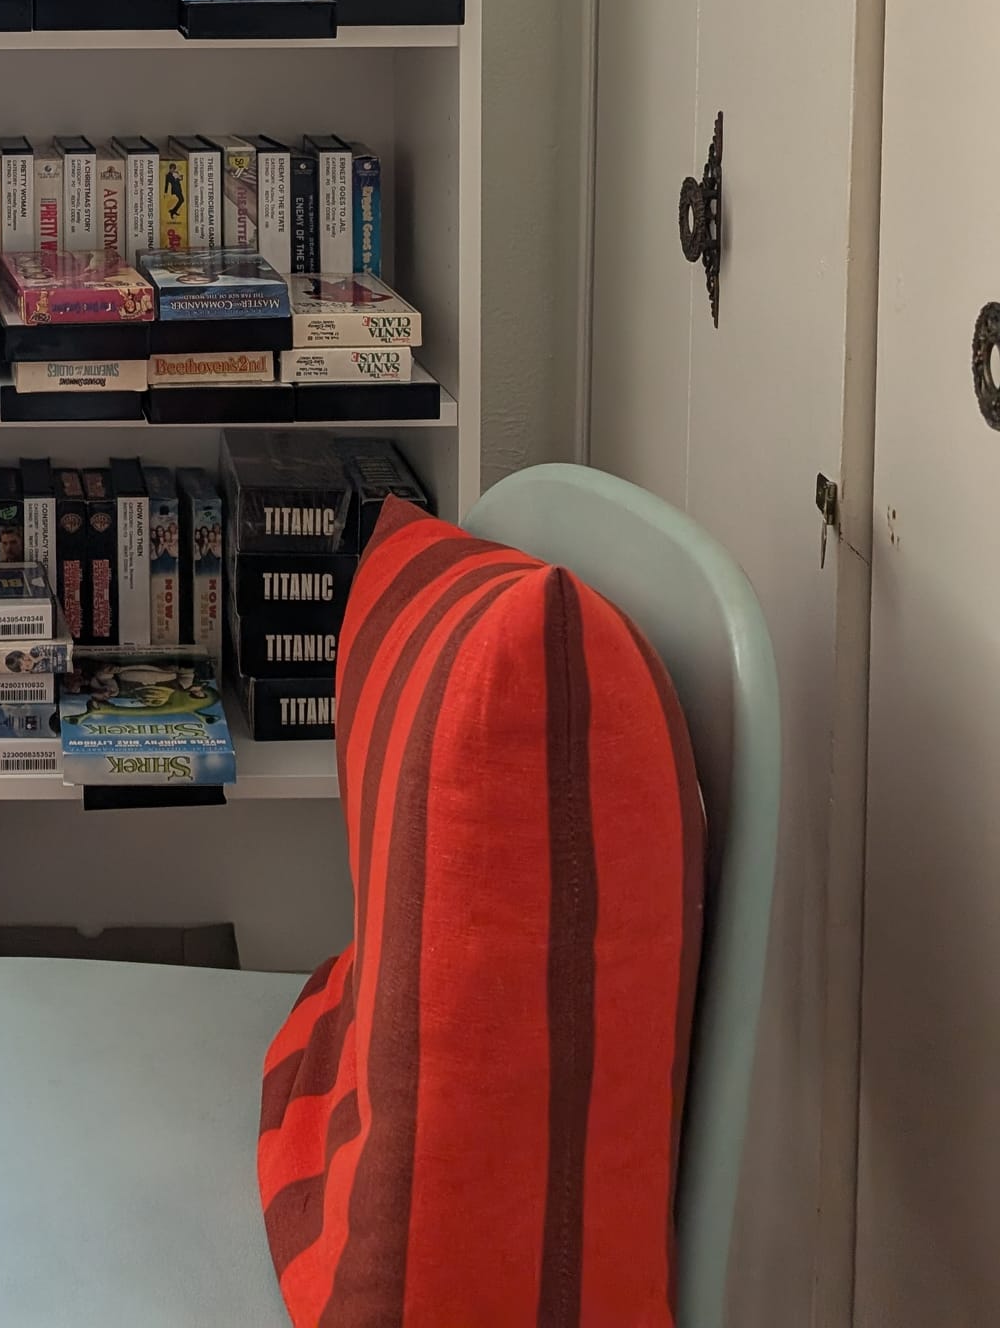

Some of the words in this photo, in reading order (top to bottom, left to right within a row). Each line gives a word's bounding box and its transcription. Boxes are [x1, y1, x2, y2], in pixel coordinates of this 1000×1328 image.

[170, 300, 233, 311] COMMANDER
[246, 299, 280, 310] MASTER
[362, 316, 412, 328] CLAUSE
[368, 327, 412, 337] SANTA
[351, 351, 400, 364] CLAUSE
[155, 355, 239, 376] Beethoven's
[239, 355, 267, 374] 2nd
[357, 363, 400, 373] SANTA
[264, 507, 335, 536] TITANIC
[262, 573, 334, 601] TITANIC
[265, 634, 336, 662] TITANIC
[279, 698, 336, 725] TITANI
